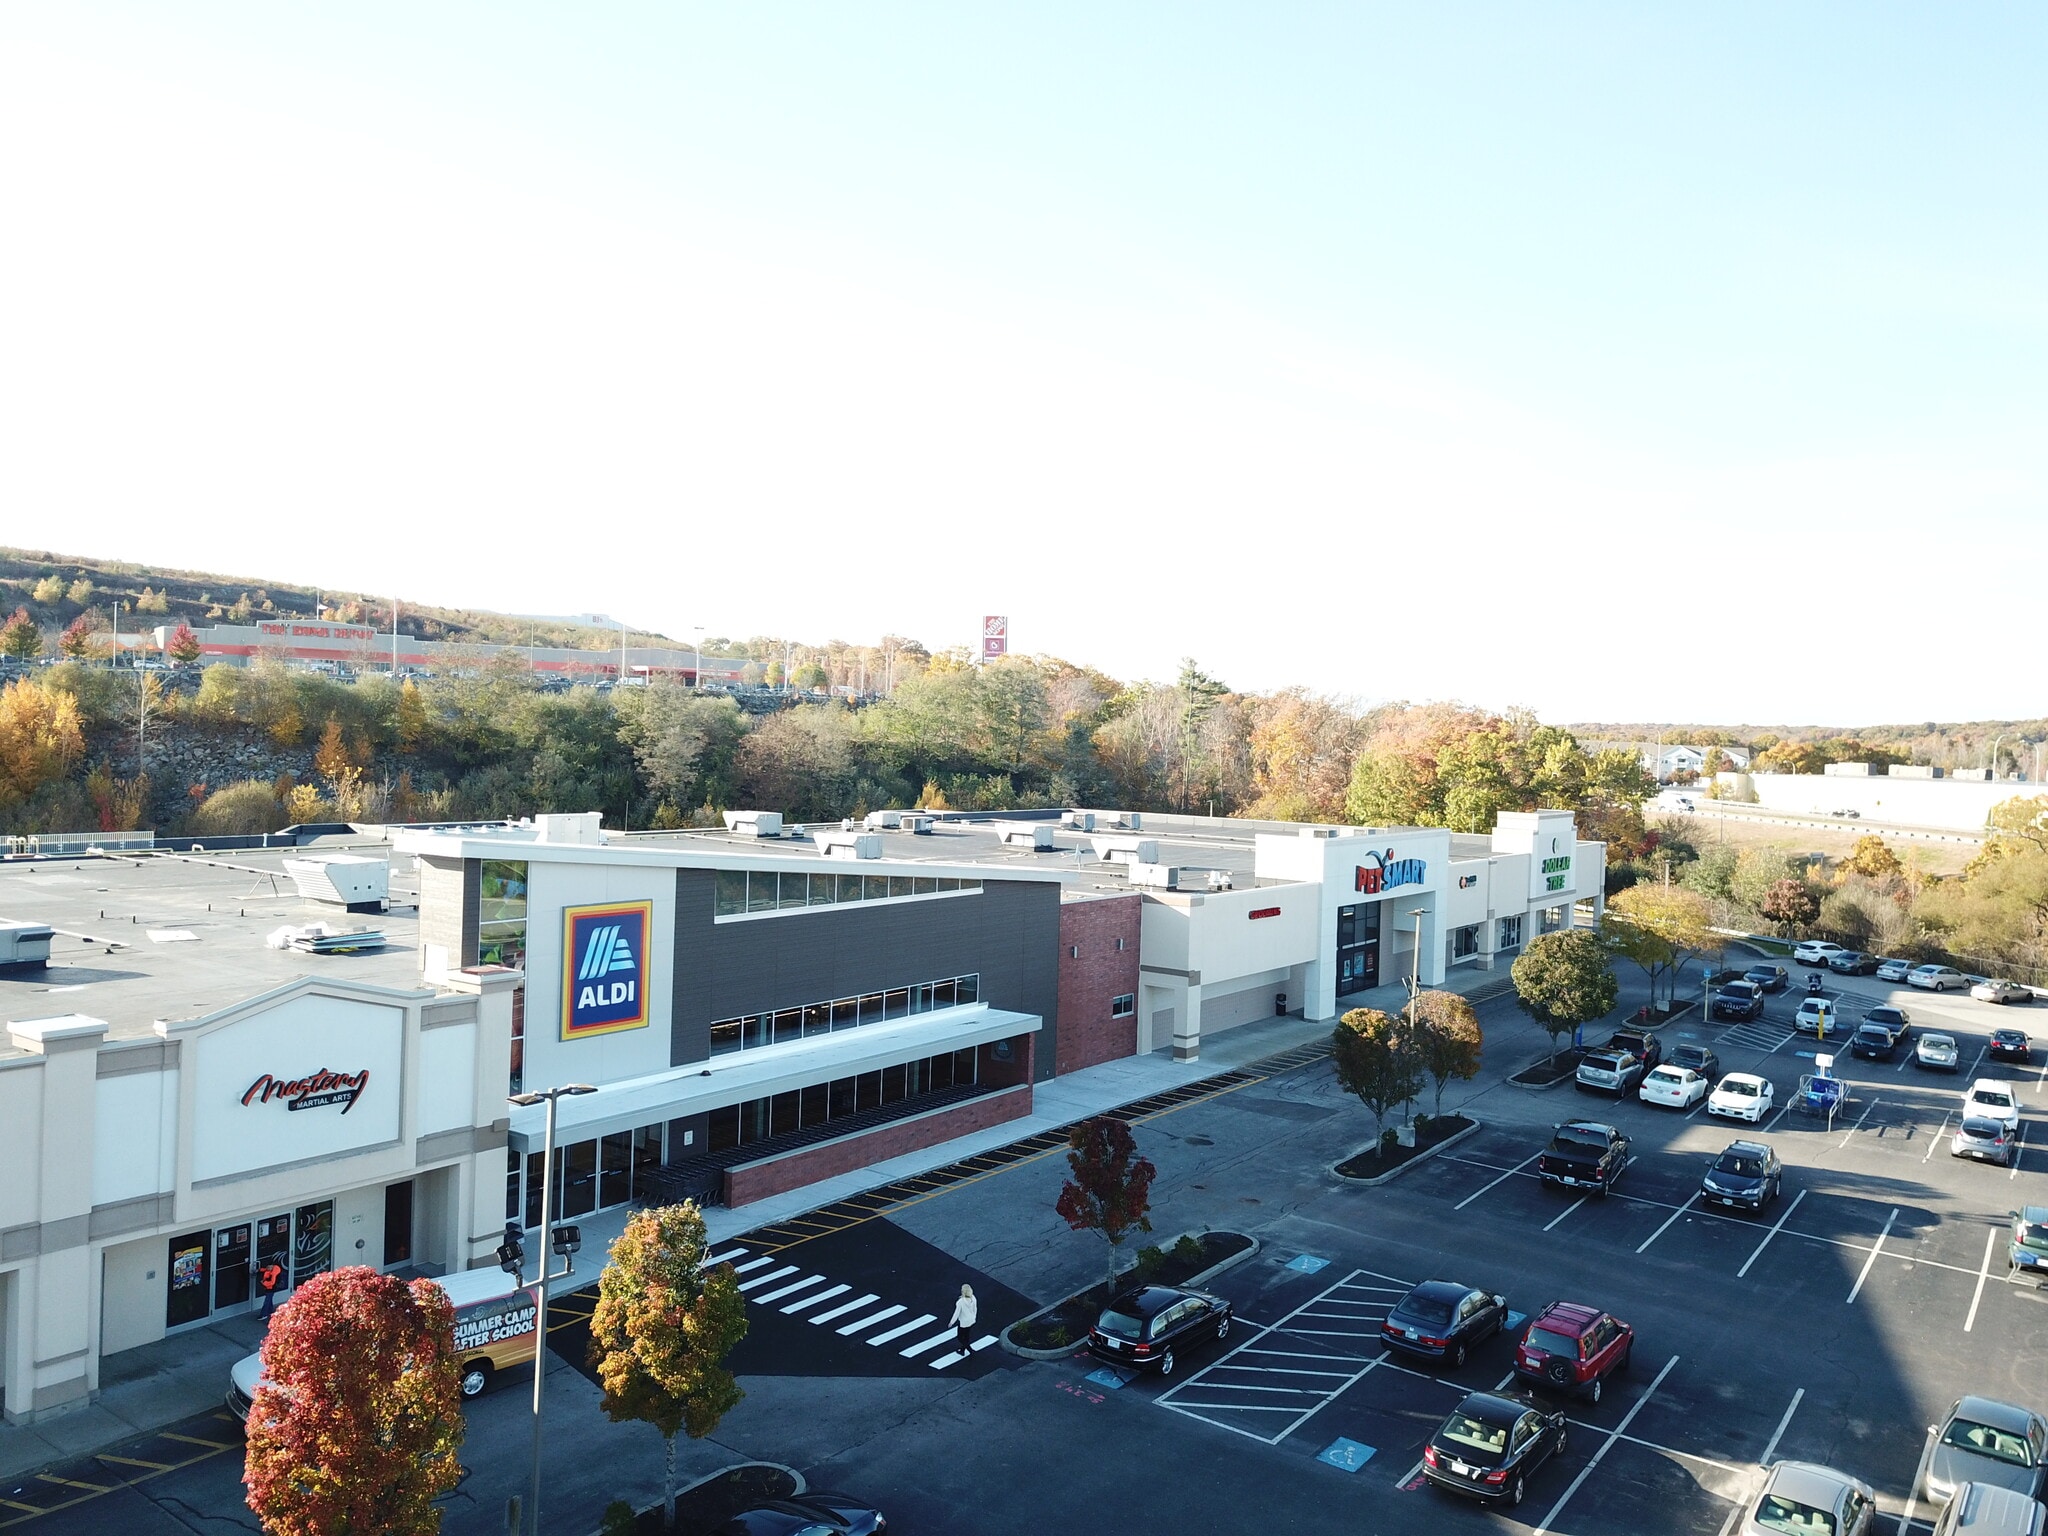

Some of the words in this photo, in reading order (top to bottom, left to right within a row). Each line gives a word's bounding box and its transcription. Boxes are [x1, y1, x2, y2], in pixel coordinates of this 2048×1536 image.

[1355, 858, 1426, 894] PETSMART
[578, 980, 635, 1009] ALDI
[241, 1067, 370, 1115] Mastery
[296, 1099, 330, 1109] MARTIAL
[332, 1093, 352, 1102] ARTS
[452, 1314, 503, 1340] SUMMER
[504, 1306, 537, 1325] CAMP
[491, 1320, 535, 1342] SCHOOL
